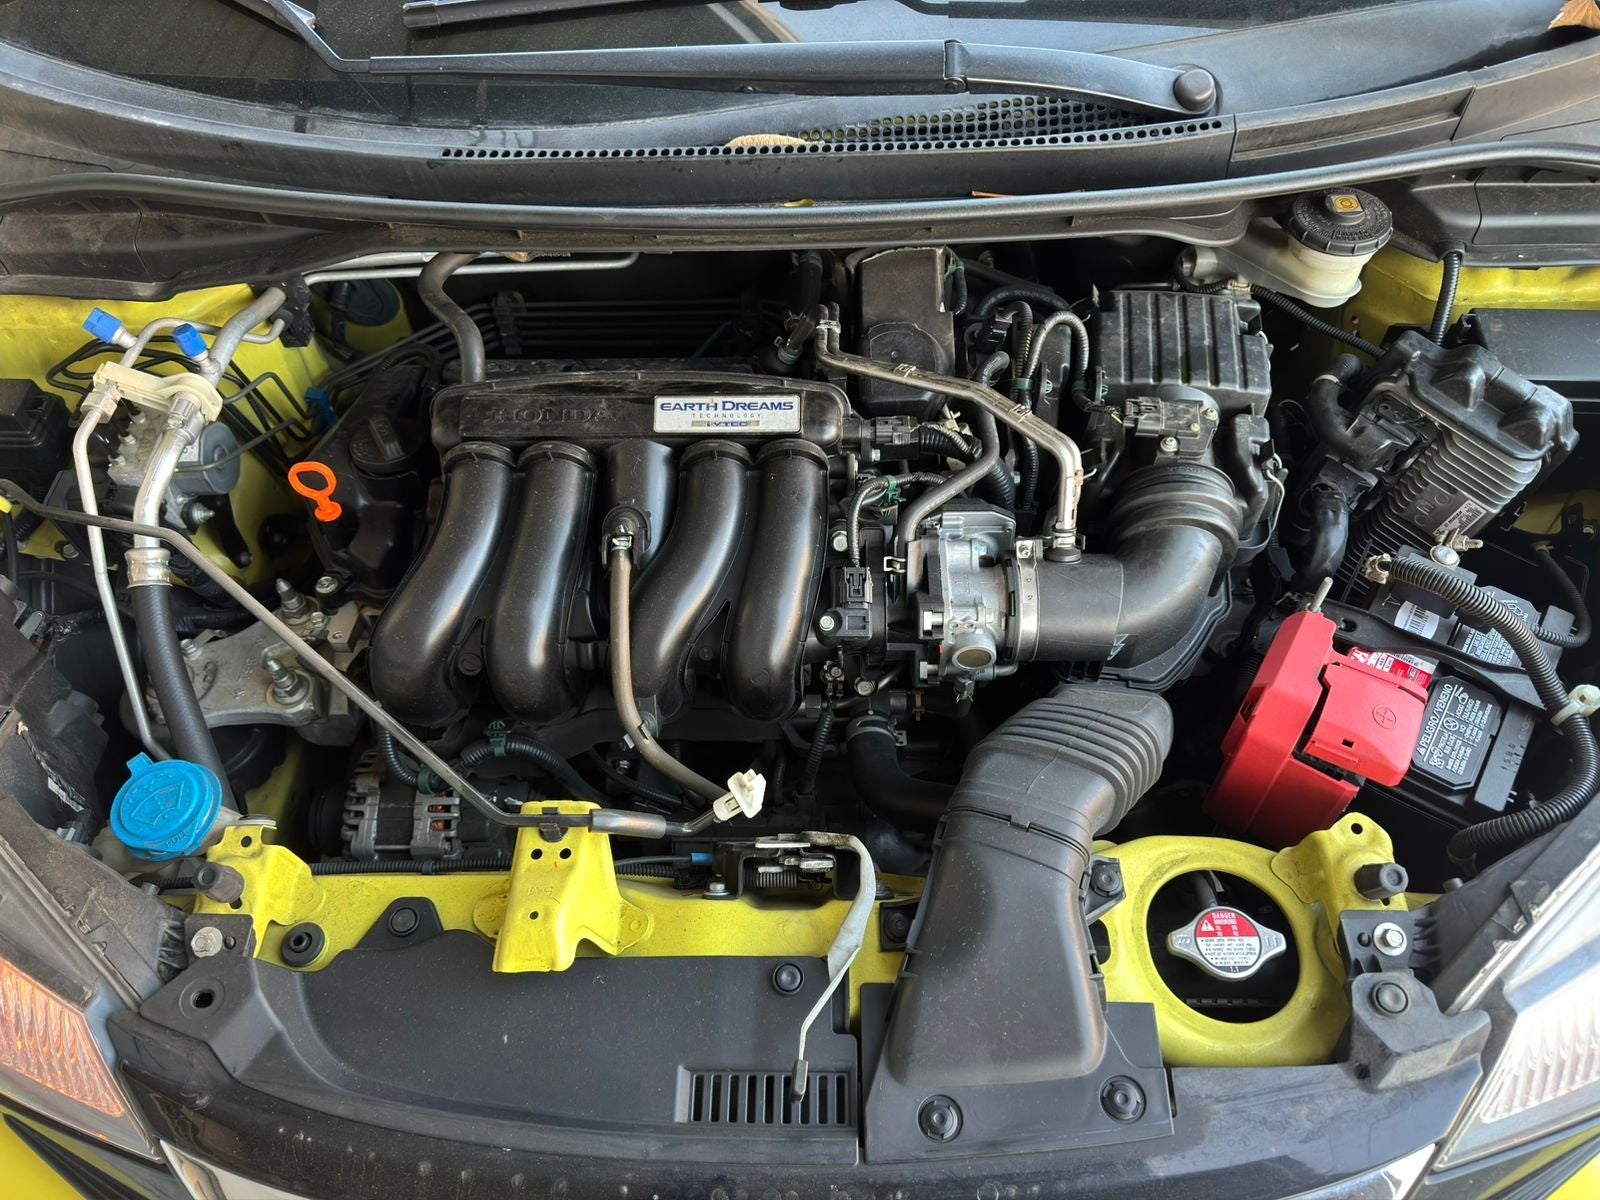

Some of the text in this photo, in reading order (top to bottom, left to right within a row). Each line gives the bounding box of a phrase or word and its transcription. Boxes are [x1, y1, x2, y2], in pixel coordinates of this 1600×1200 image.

[660, 401, 794, 411] EARTH DREAMS
[1420, 684, 1453, 753] PELIGRO/VENENO
[1229, 965, 1239, 973] 1.1
